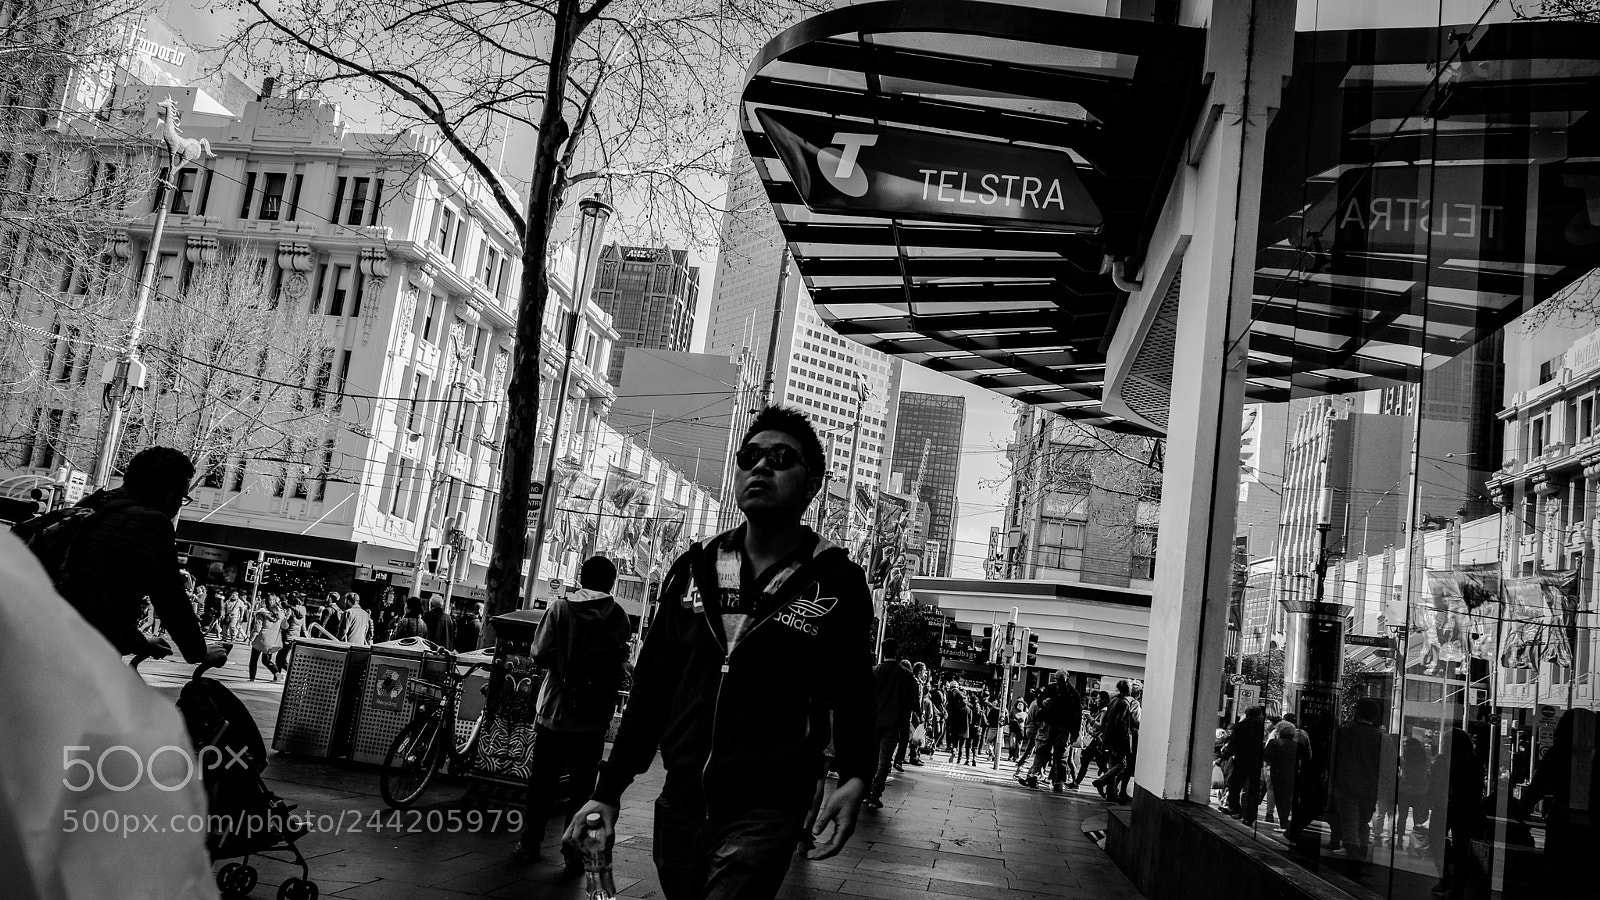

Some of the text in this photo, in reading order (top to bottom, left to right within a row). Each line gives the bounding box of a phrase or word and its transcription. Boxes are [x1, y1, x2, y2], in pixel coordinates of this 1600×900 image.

[919, 169, 1065, 211] TELSTRA
[989, 531, 998, 562] DAVID
[267, 557, 312, 569] michael hill
[939, 647, 977, 660] Strandbags
